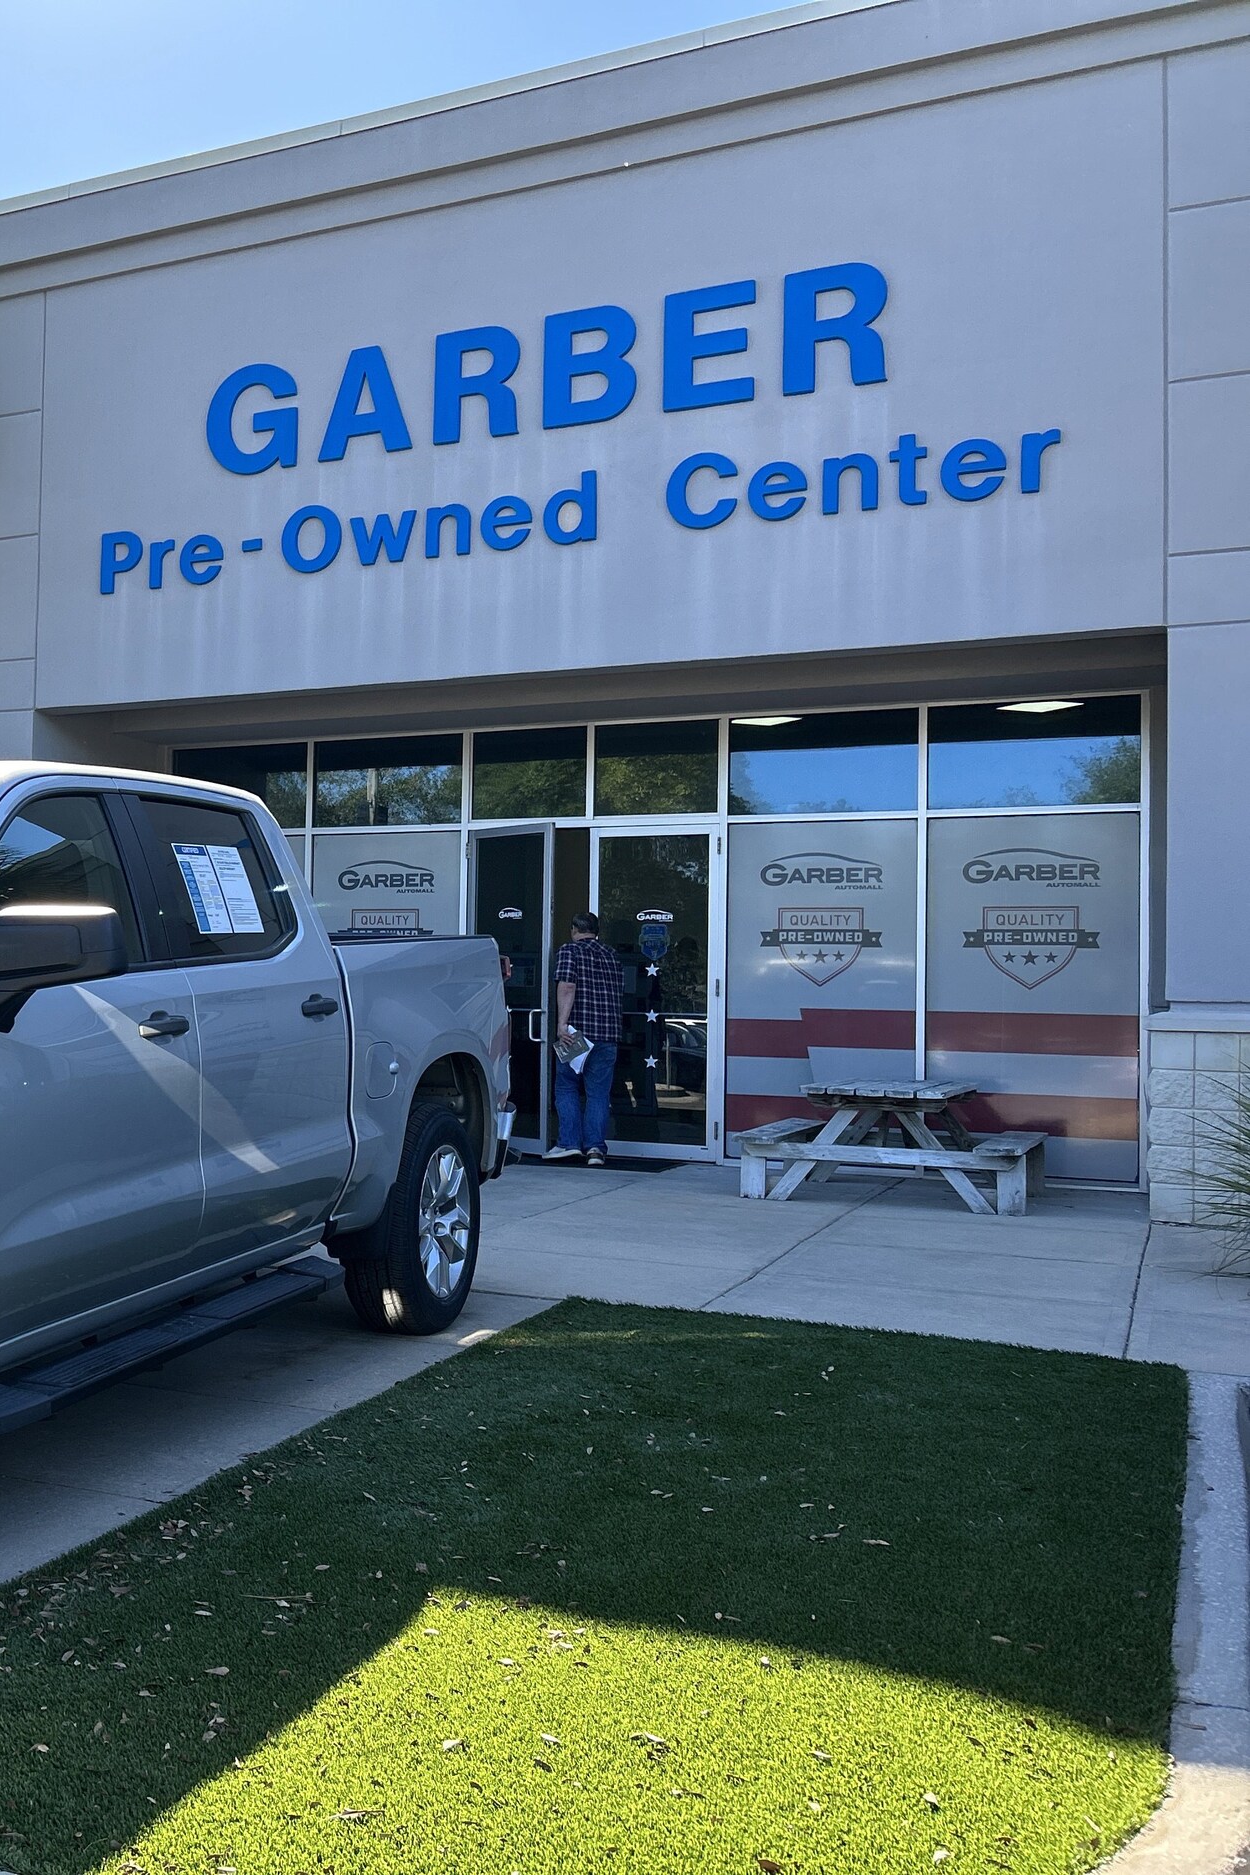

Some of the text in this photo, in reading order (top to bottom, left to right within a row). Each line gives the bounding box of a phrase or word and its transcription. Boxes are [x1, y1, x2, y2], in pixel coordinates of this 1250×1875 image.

[205, 262, 889, 476] GARBER
[100, 428, 1061, 595] Pre-Owned Center
[760, 863, 884, 887] GARBER
[962, 859, 1101, 884] GARBER
[337, 870, 436, 891] GARBER
[359, 914, 411, 927] QUALITY
[789, 914, 852, 927] QUALITY
[995, 913, 1066, 926] QUALITY
[778, 931, 864, 943] PRE-OWNED
[982, 931, 1079, 944] PRE-OWNED
